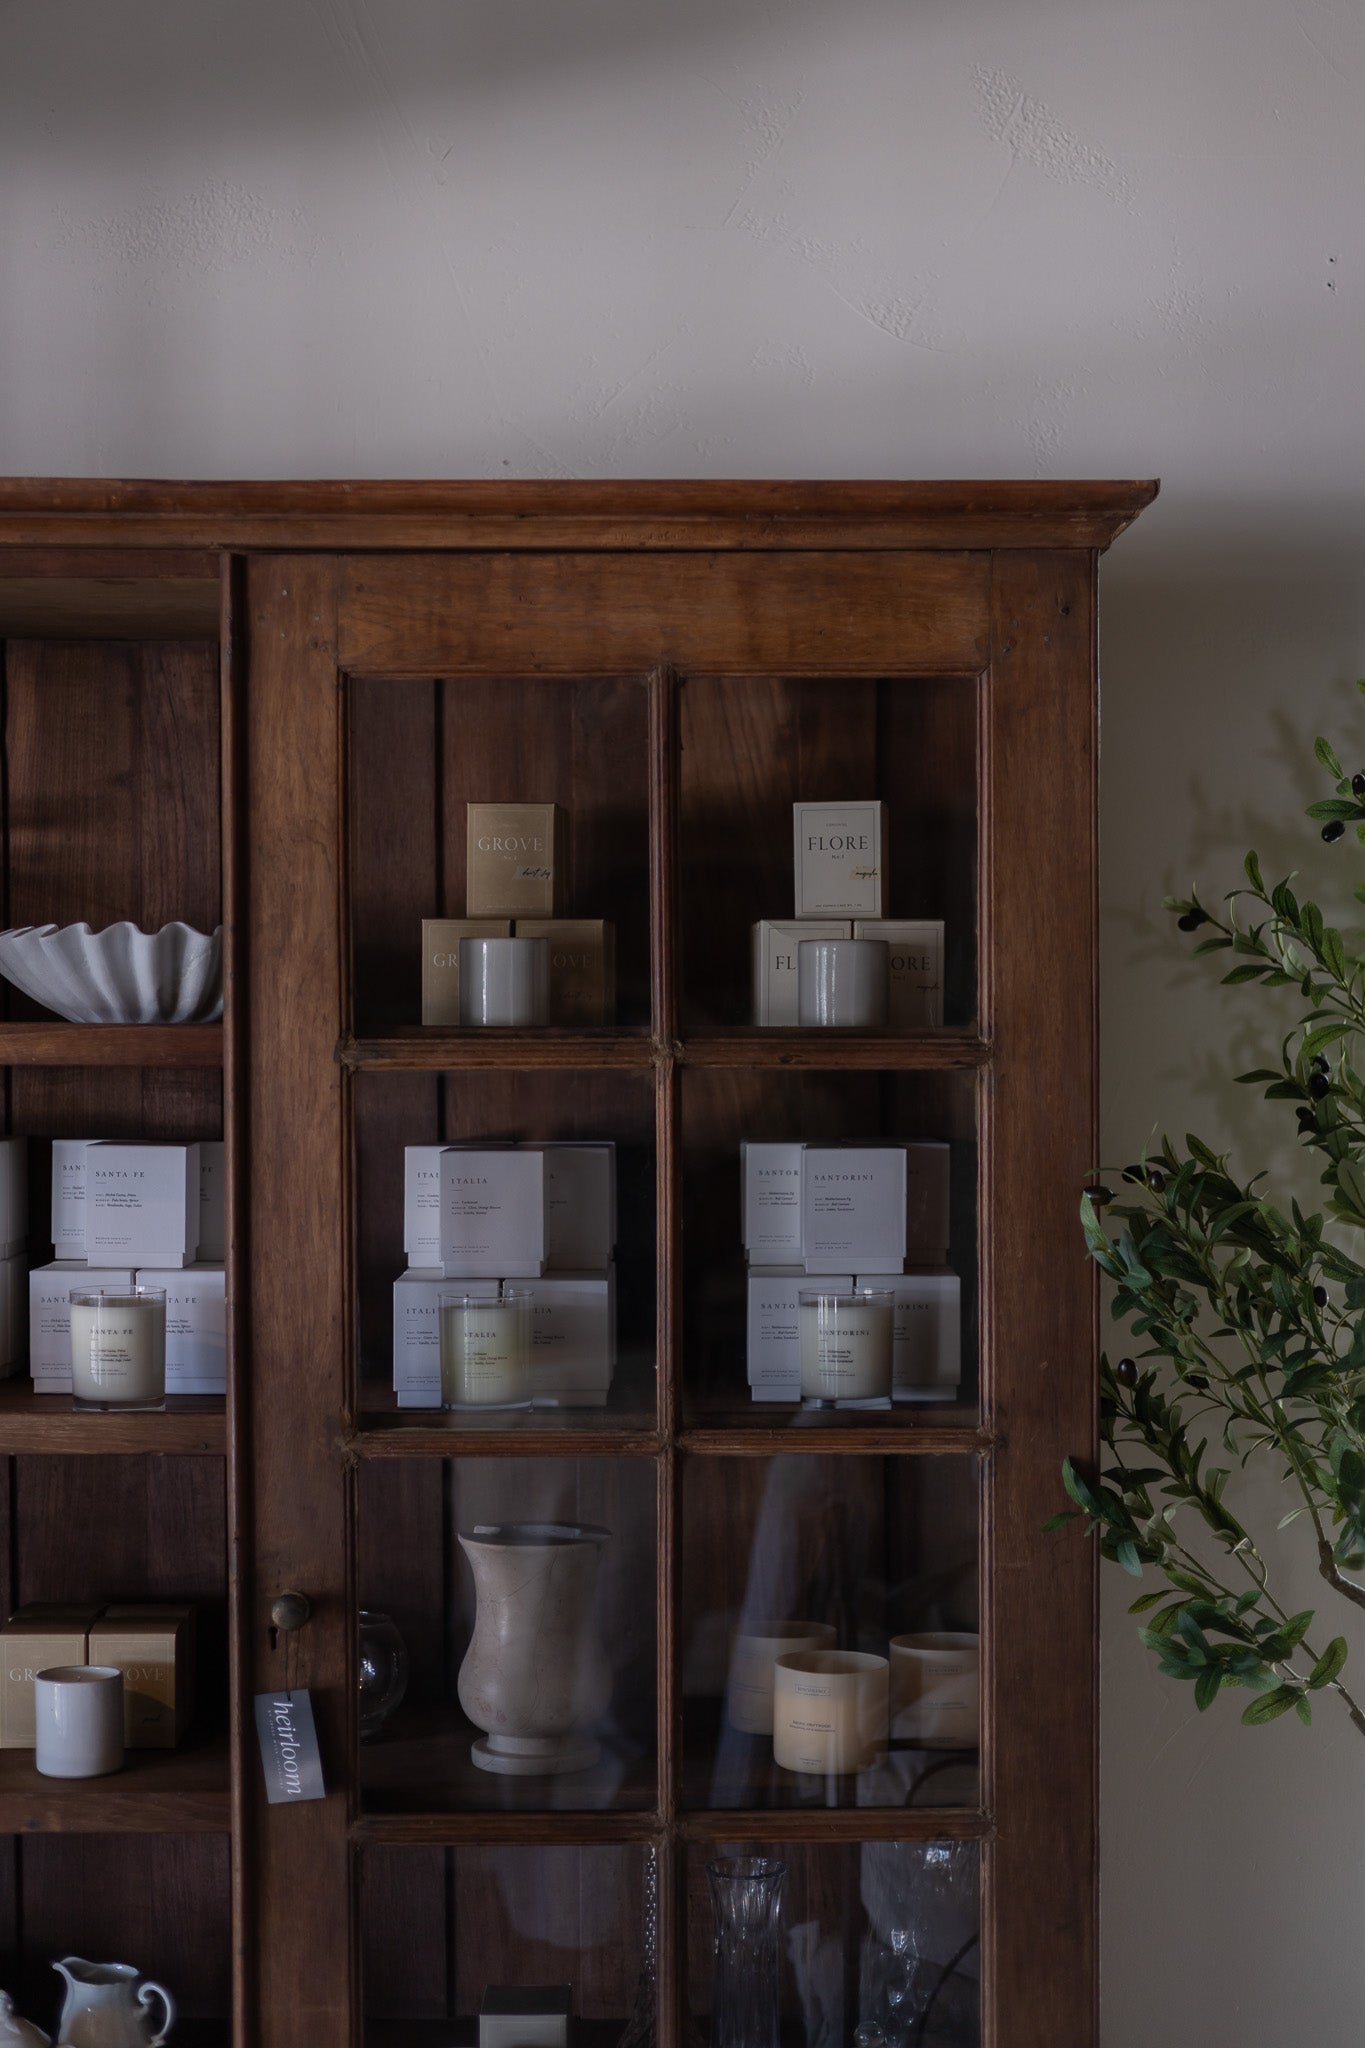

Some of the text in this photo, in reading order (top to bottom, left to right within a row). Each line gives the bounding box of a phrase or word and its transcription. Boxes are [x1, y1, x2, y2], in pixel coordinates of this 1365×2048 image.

[478, 836, 544, 852] GROVE
[808, 835, 869, 851] FLORE
[553, 953, 593, 969] OVE
[891, 956, 931, 970] ORE
[126, 1667, 164, 1681] OVE
[273, 1702, 302, 1795] heirloom
